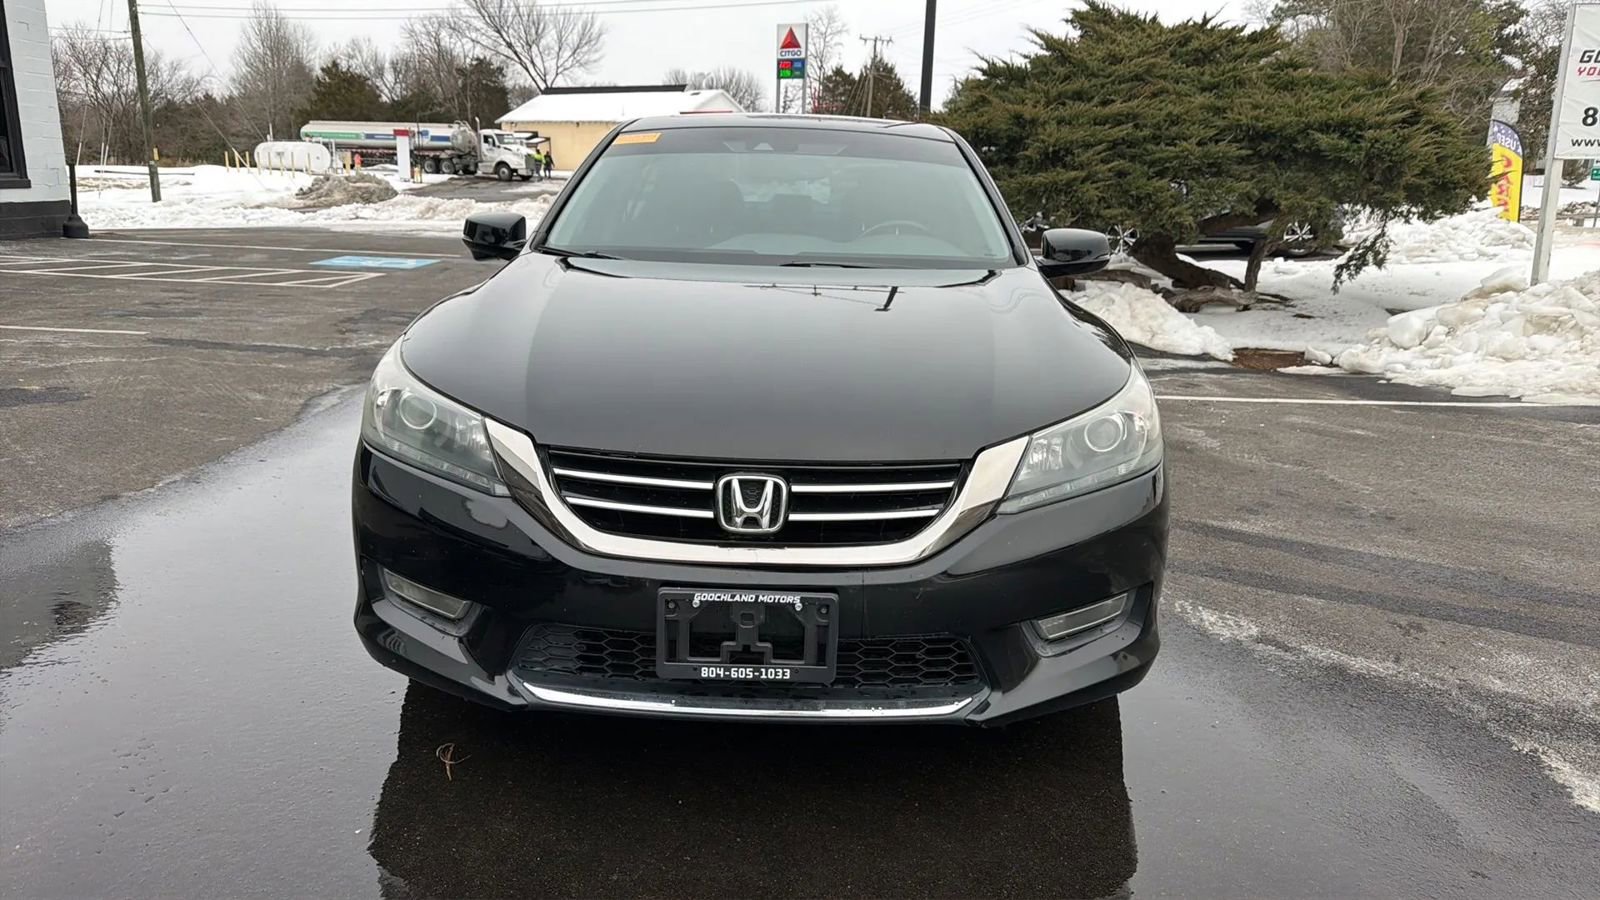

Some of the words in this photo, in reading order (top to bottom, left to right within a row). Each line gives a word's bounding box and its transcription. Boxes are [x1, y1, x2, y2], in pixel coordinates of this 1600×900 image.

[693, 593, 756, 602] GOOCHLAND
[758, 594, 801, 604] MOTORS
[701, 666, 791, 679] 804-605-1033
